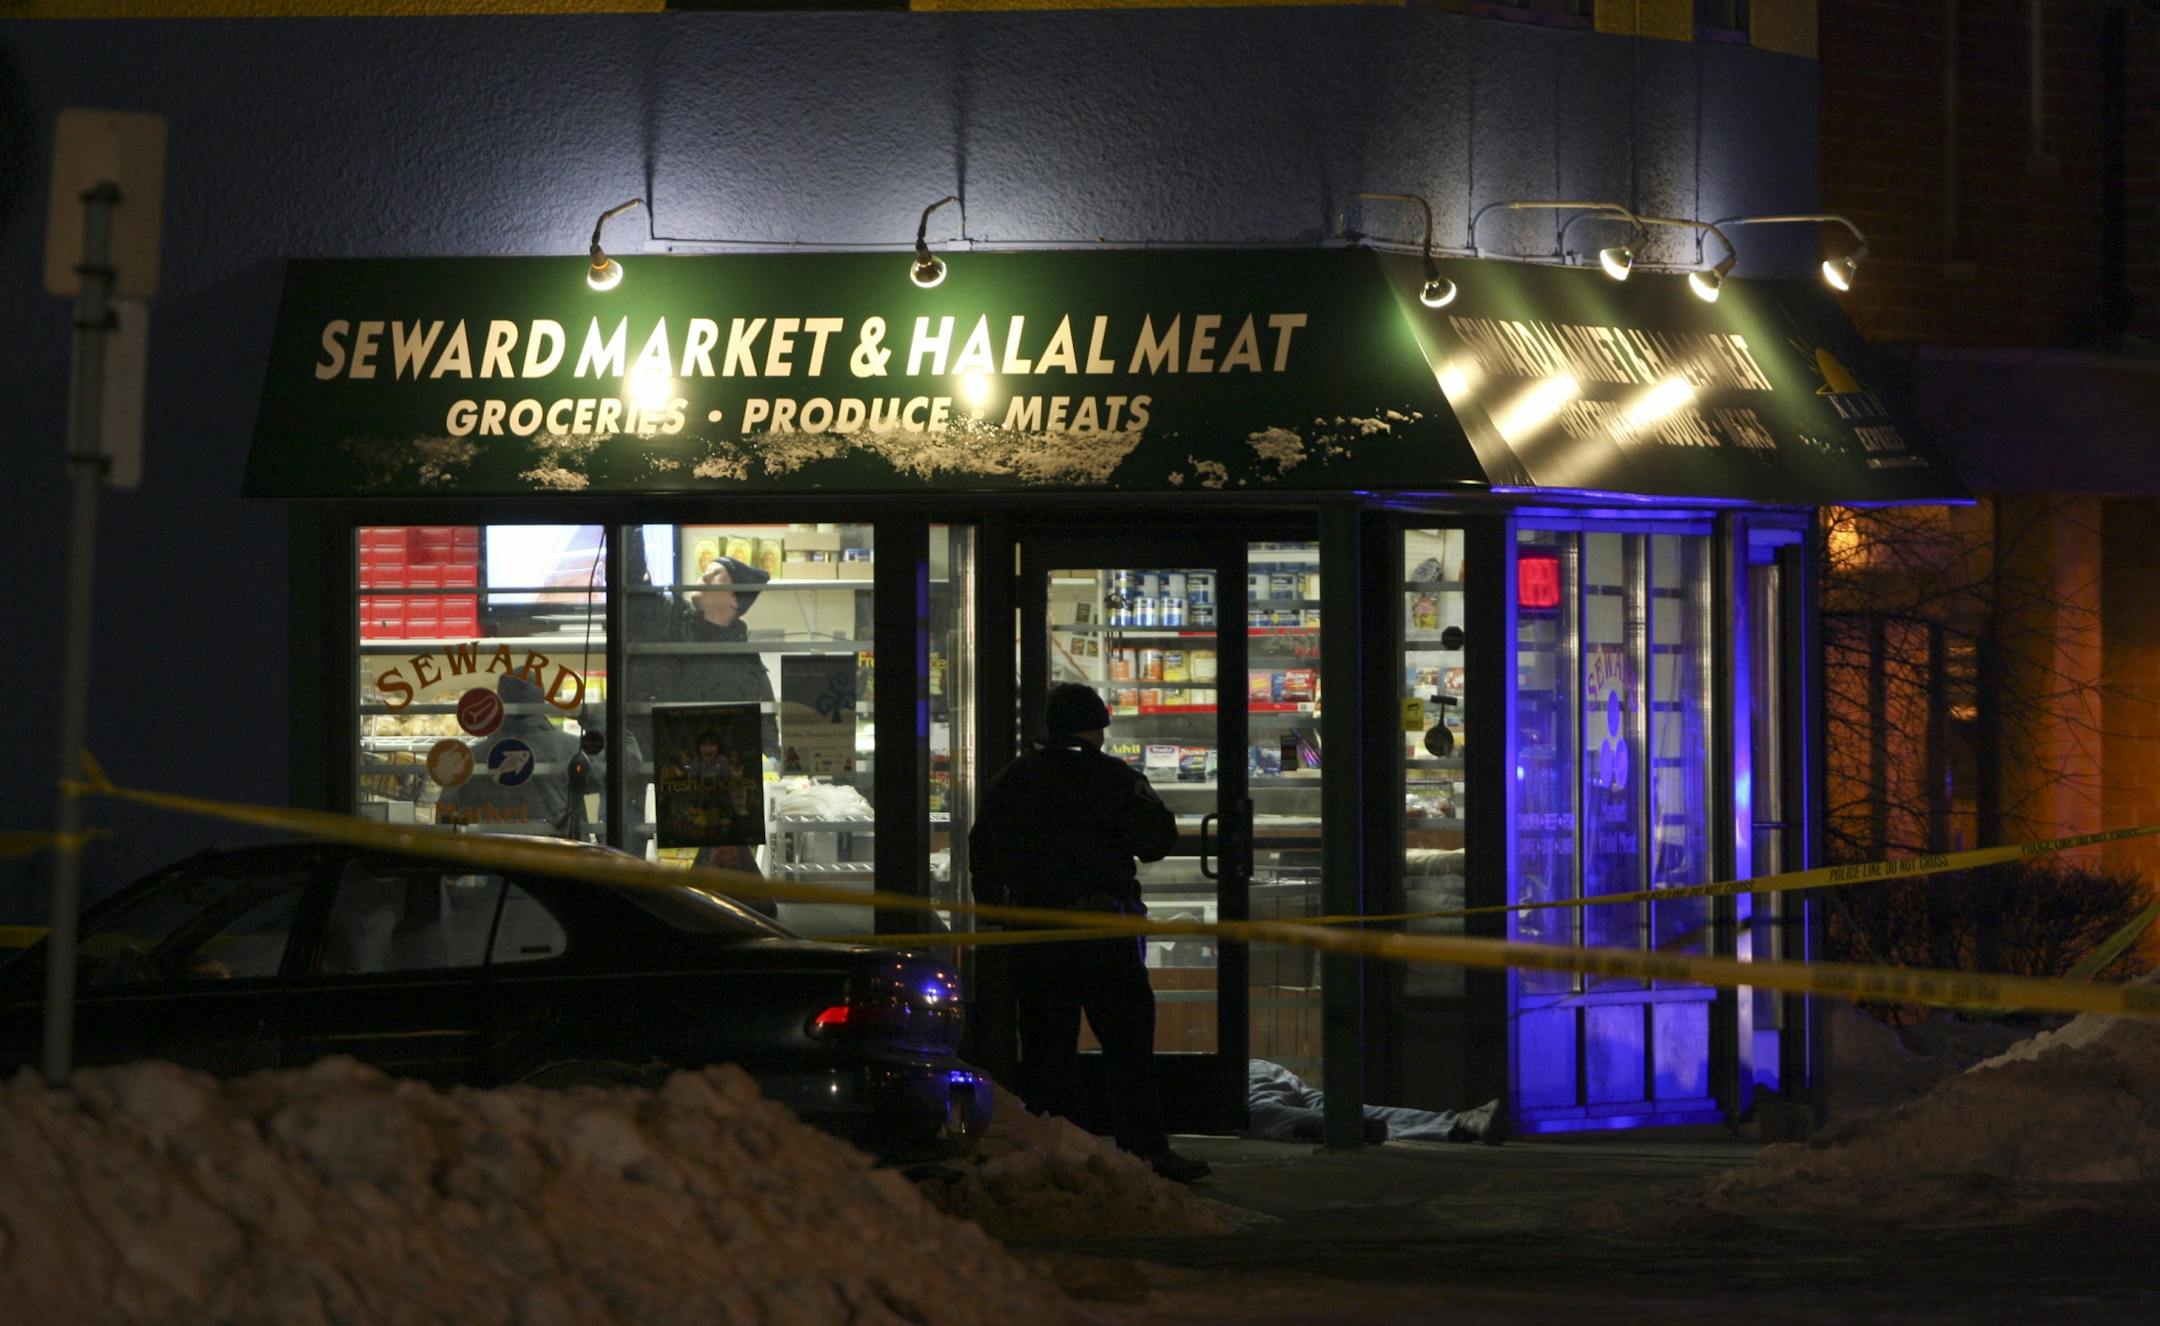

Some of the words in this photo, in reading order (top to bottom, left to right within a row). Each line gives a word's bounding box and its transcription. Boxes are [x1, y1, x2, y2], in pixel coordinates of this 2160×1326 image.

[315, 318, 566, 380] SEWARD
[573, 316, 844, 379] MARKET
[850, 316, 892, 377] &
[906, 313, 1115, 376] HALAL
[1129, 312, 1307, 374] MEAT
[446, 397, 688, 437] GROCERIES
[741, 396, 952, 435] PRODUCE
[1004, 395, 1152, 434] MEATS
[377, 641, 585, 711] SEWARD
[1829, 866, 1859, 882] POLICE
[1863, 863, 1880, 878] LINE
[1885, 861, 1897, 874] DO
[1900, 858, 1916, 872] NOT
[1920, 855, 1949, 871] CROSS
